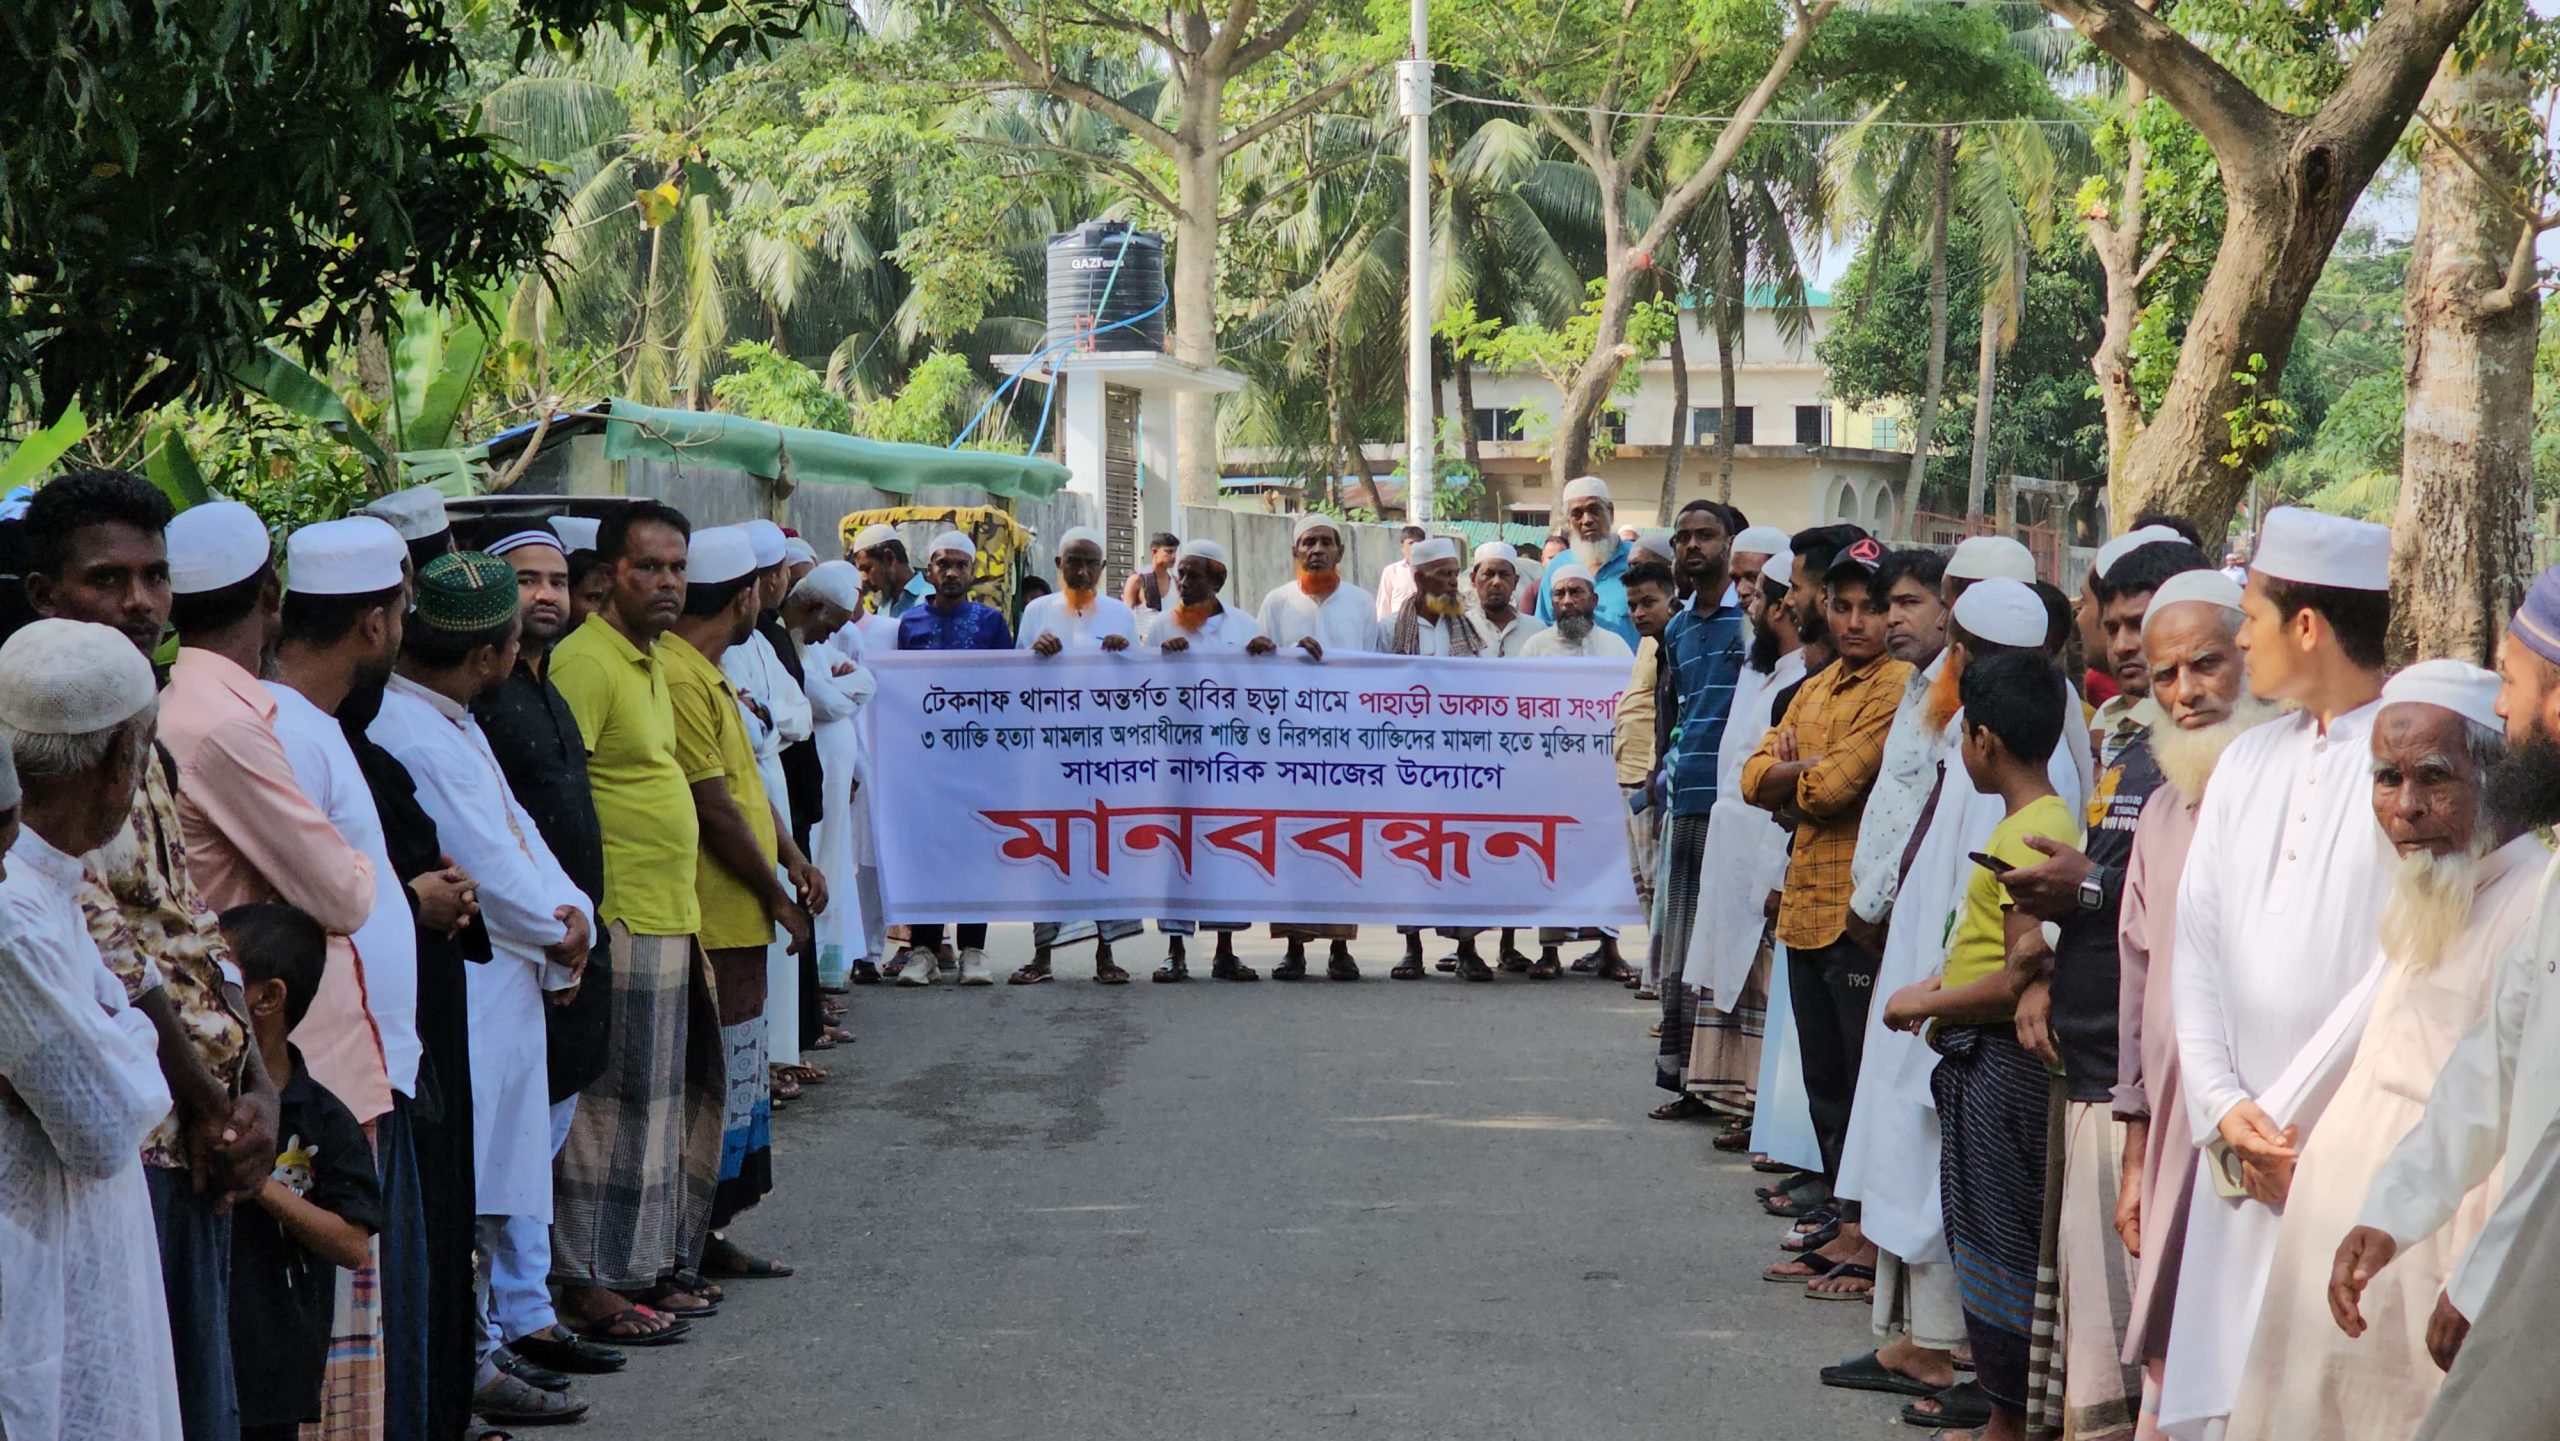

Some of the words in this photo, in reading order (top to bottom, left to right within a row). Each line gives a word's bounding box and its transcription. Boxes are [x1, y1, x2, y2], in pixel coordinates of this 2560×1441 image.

[923, 684, 1011, 714] টেকনাফ
[1019, 687, 1083, 713] থানার
[1089, 679, 1170, 711] অন্তর্গত
[1176, 679, 1237, 712] হাবির
[1245, 686, 1289, 716] ছড়া
[1295, 687, 1349, 713] গ্রামে
[1359, 684, 1431, 718] পাহাড়ী
[1438, 694, 1509, 717] ডাকাত
[1516, 696, 1561, 720] দ্বারা
[921, 731, 935, 749] ৩
[994, 725, 1035, 751] হত্যা
[1041, 724, 1104, 749] মামলার
[1109, 715, 1204, 747] অপরাধীদের
[1209, 717, 1250, 746] শাস্তি
[1257, 727, 1271, 745] ও
[1278, 718, 1352, 748] নিরপরাধ
[1441, 728, 1492, 752] মামলা
[1498, 731, 1534, 755] হতে
[1539, 725, 1586, 759] মুক্তির
[1060, 756, 1160, 785] সাধারণ
[1166, 751, 1267, 785] নাগরিক
[1275, 759, 1387, 787] সমাজের
[1395, 755, 1506, 790] উদ্যোগে
[977, 797, 1582, 885] মানববন্ধন
